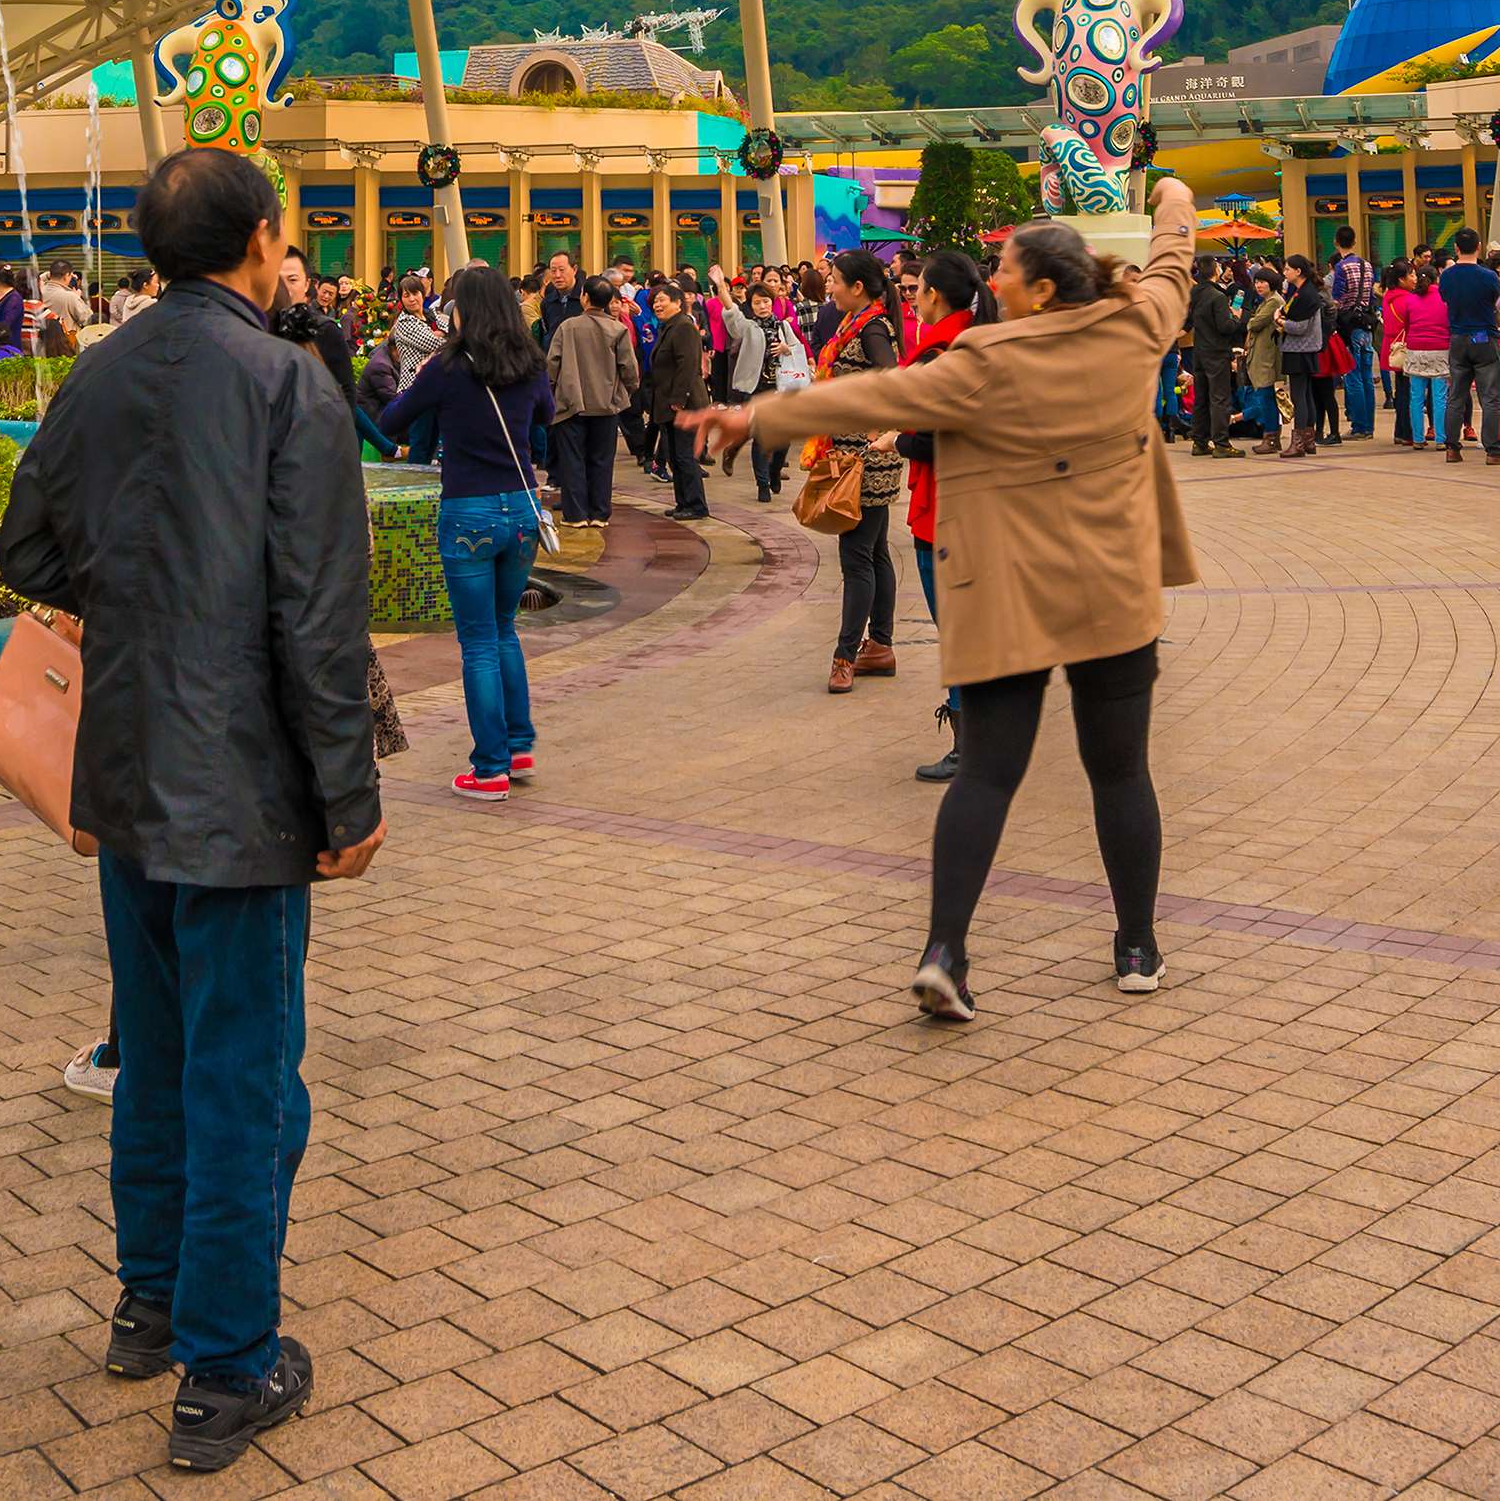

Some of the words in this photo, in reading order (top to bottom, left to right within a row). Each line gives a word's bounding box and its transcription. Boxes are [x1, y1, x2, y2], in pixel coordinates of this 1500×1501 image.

[1185, 76, 1245, 90] 海洋奇觀
[1188, 92, 1236, 101] AQUARIUM
